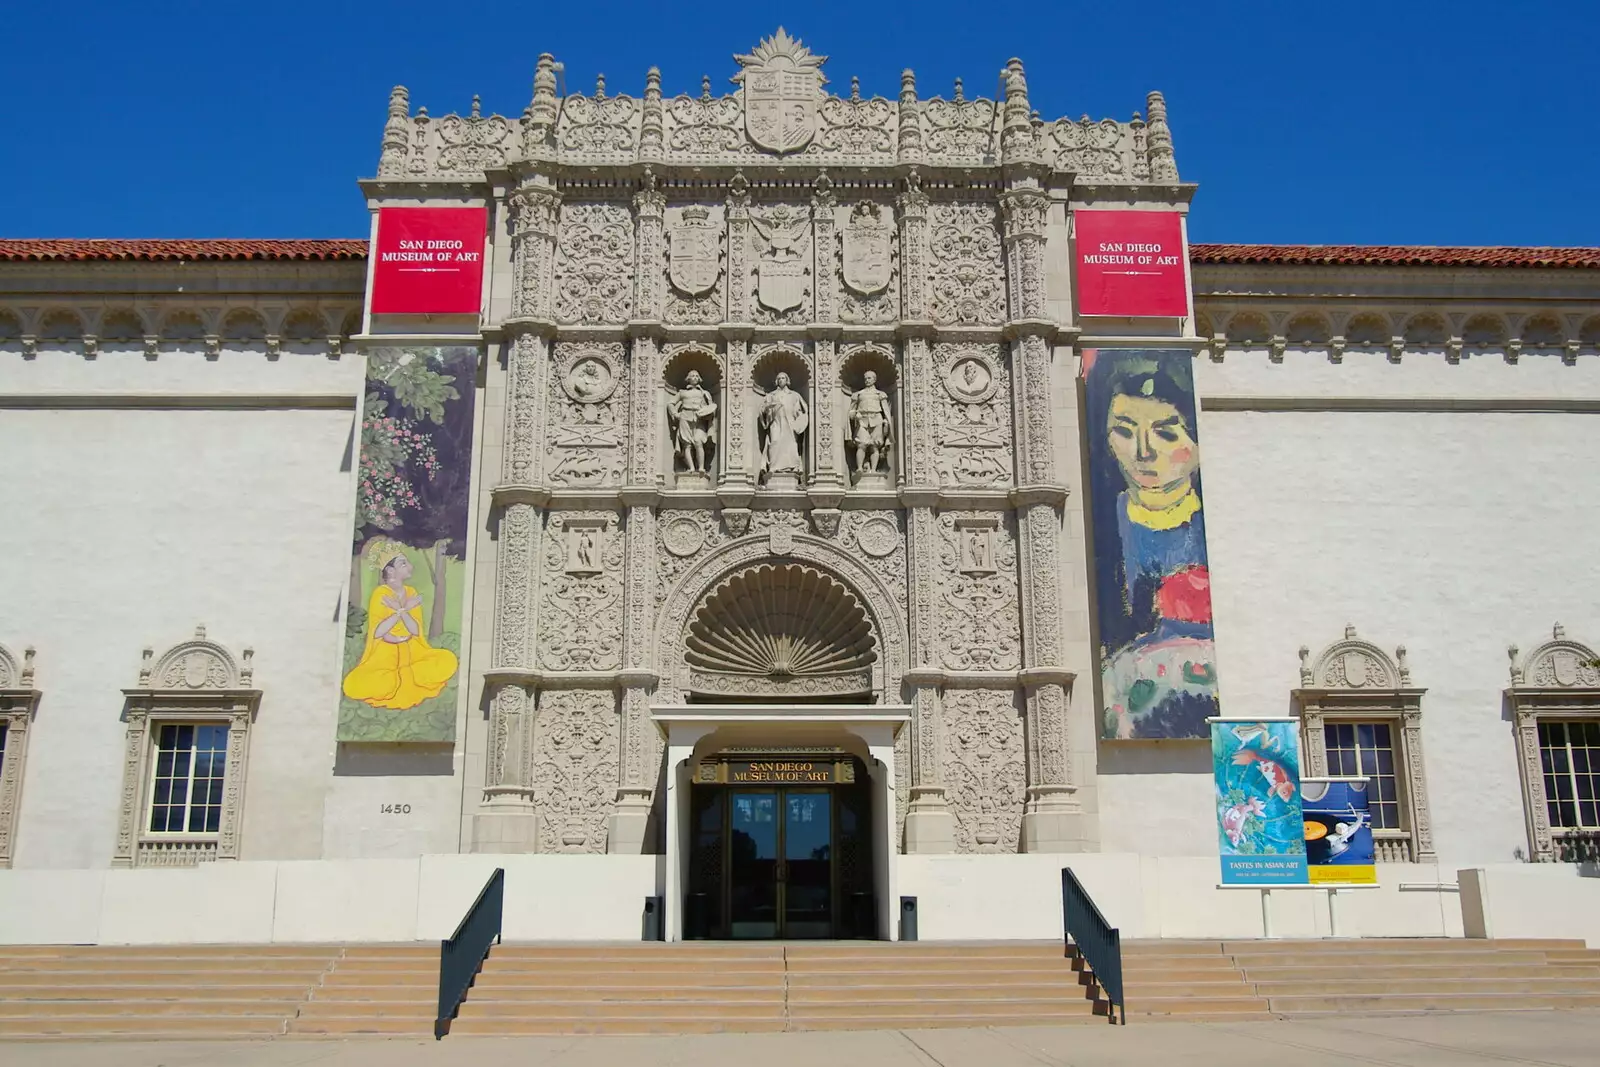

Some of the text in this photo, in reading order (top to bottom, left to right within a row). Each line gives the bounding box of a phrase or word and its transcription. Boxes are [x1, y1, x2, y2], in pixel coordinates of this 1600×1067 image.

[399, 240, 463, 250] SAN DIEGO
[1099, 243, 1161, 253] SAN DIEGO
[382, 252, 479, 262] MUSEUM OF ART
[1084, 254, 1179, 265] MUSEUM OF ART
[750, 762, 812, 772] SAN DIEGO
[734, 772, 829, 781] MUSEUM OF ART
[380, 803, 412, 814] 1450
[1230, 861, 1299, 869] TASTES IN ASIAN ART
